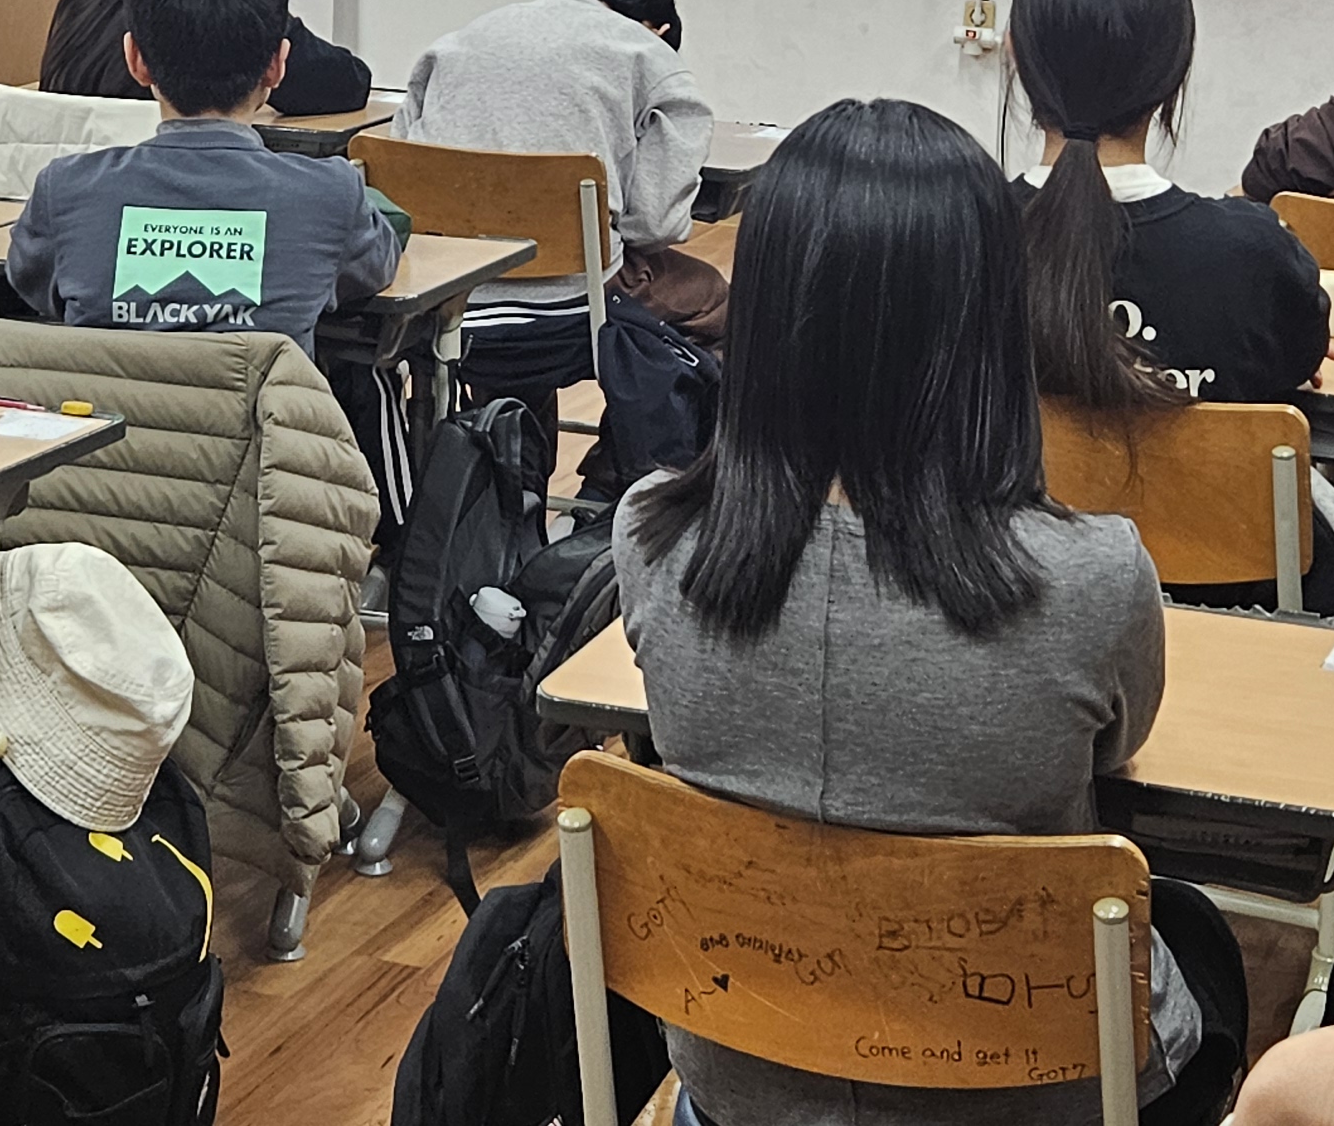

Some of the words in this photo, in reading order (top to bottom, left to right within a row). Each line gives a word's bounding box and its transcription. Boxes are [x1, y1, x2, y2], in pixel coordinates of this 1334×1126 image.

[143, 223, 205, 236] EVERYONE
[210, 225, 221, 236] IS
[224, 225, 244, 237] AN
[125, 236, 255, 262] EXPLORER
[854, 1035, 913, 1060] Come
[921, 1039, 963, 1063] and
[975, 1046, 1011, 1067] get
